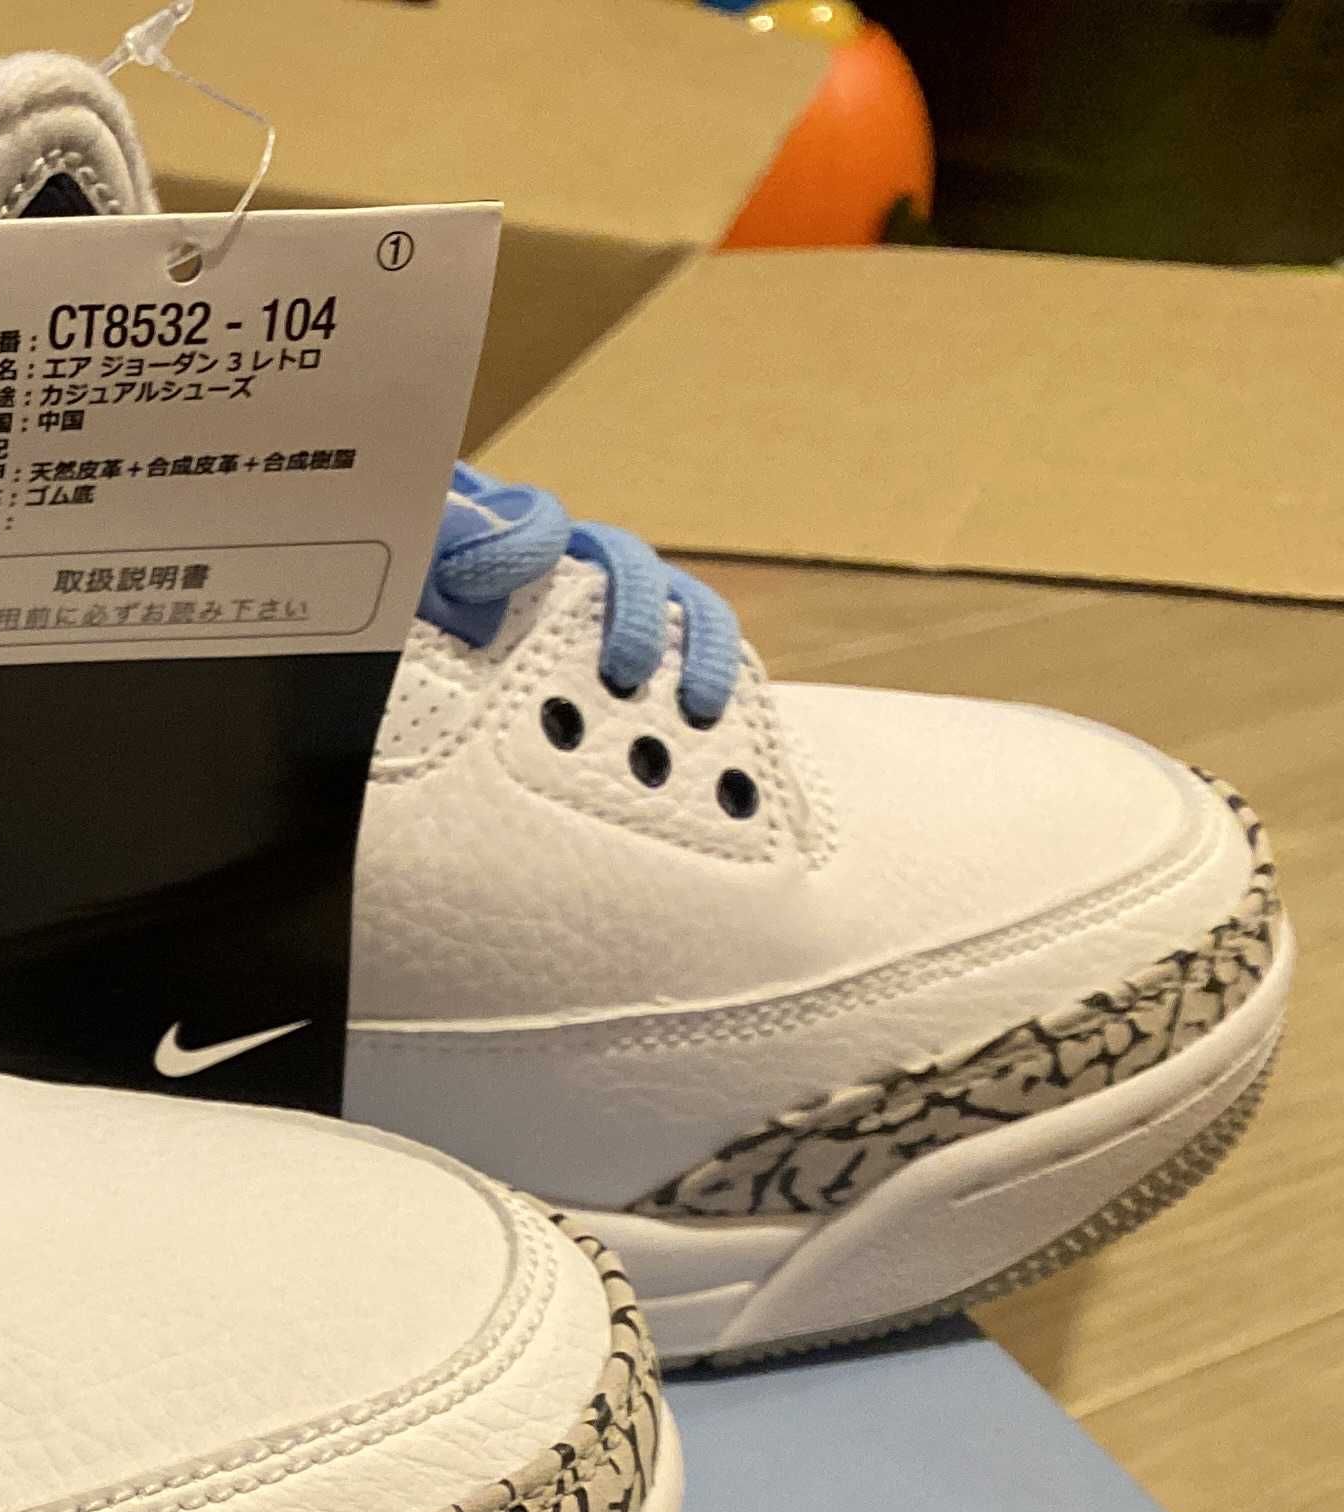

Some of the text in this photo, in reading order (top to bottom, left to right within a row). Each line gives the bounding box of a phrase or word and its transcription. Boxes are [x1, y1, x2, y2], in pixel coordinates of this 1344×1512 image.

[53, 564, 210, 593] 取扱説明書
